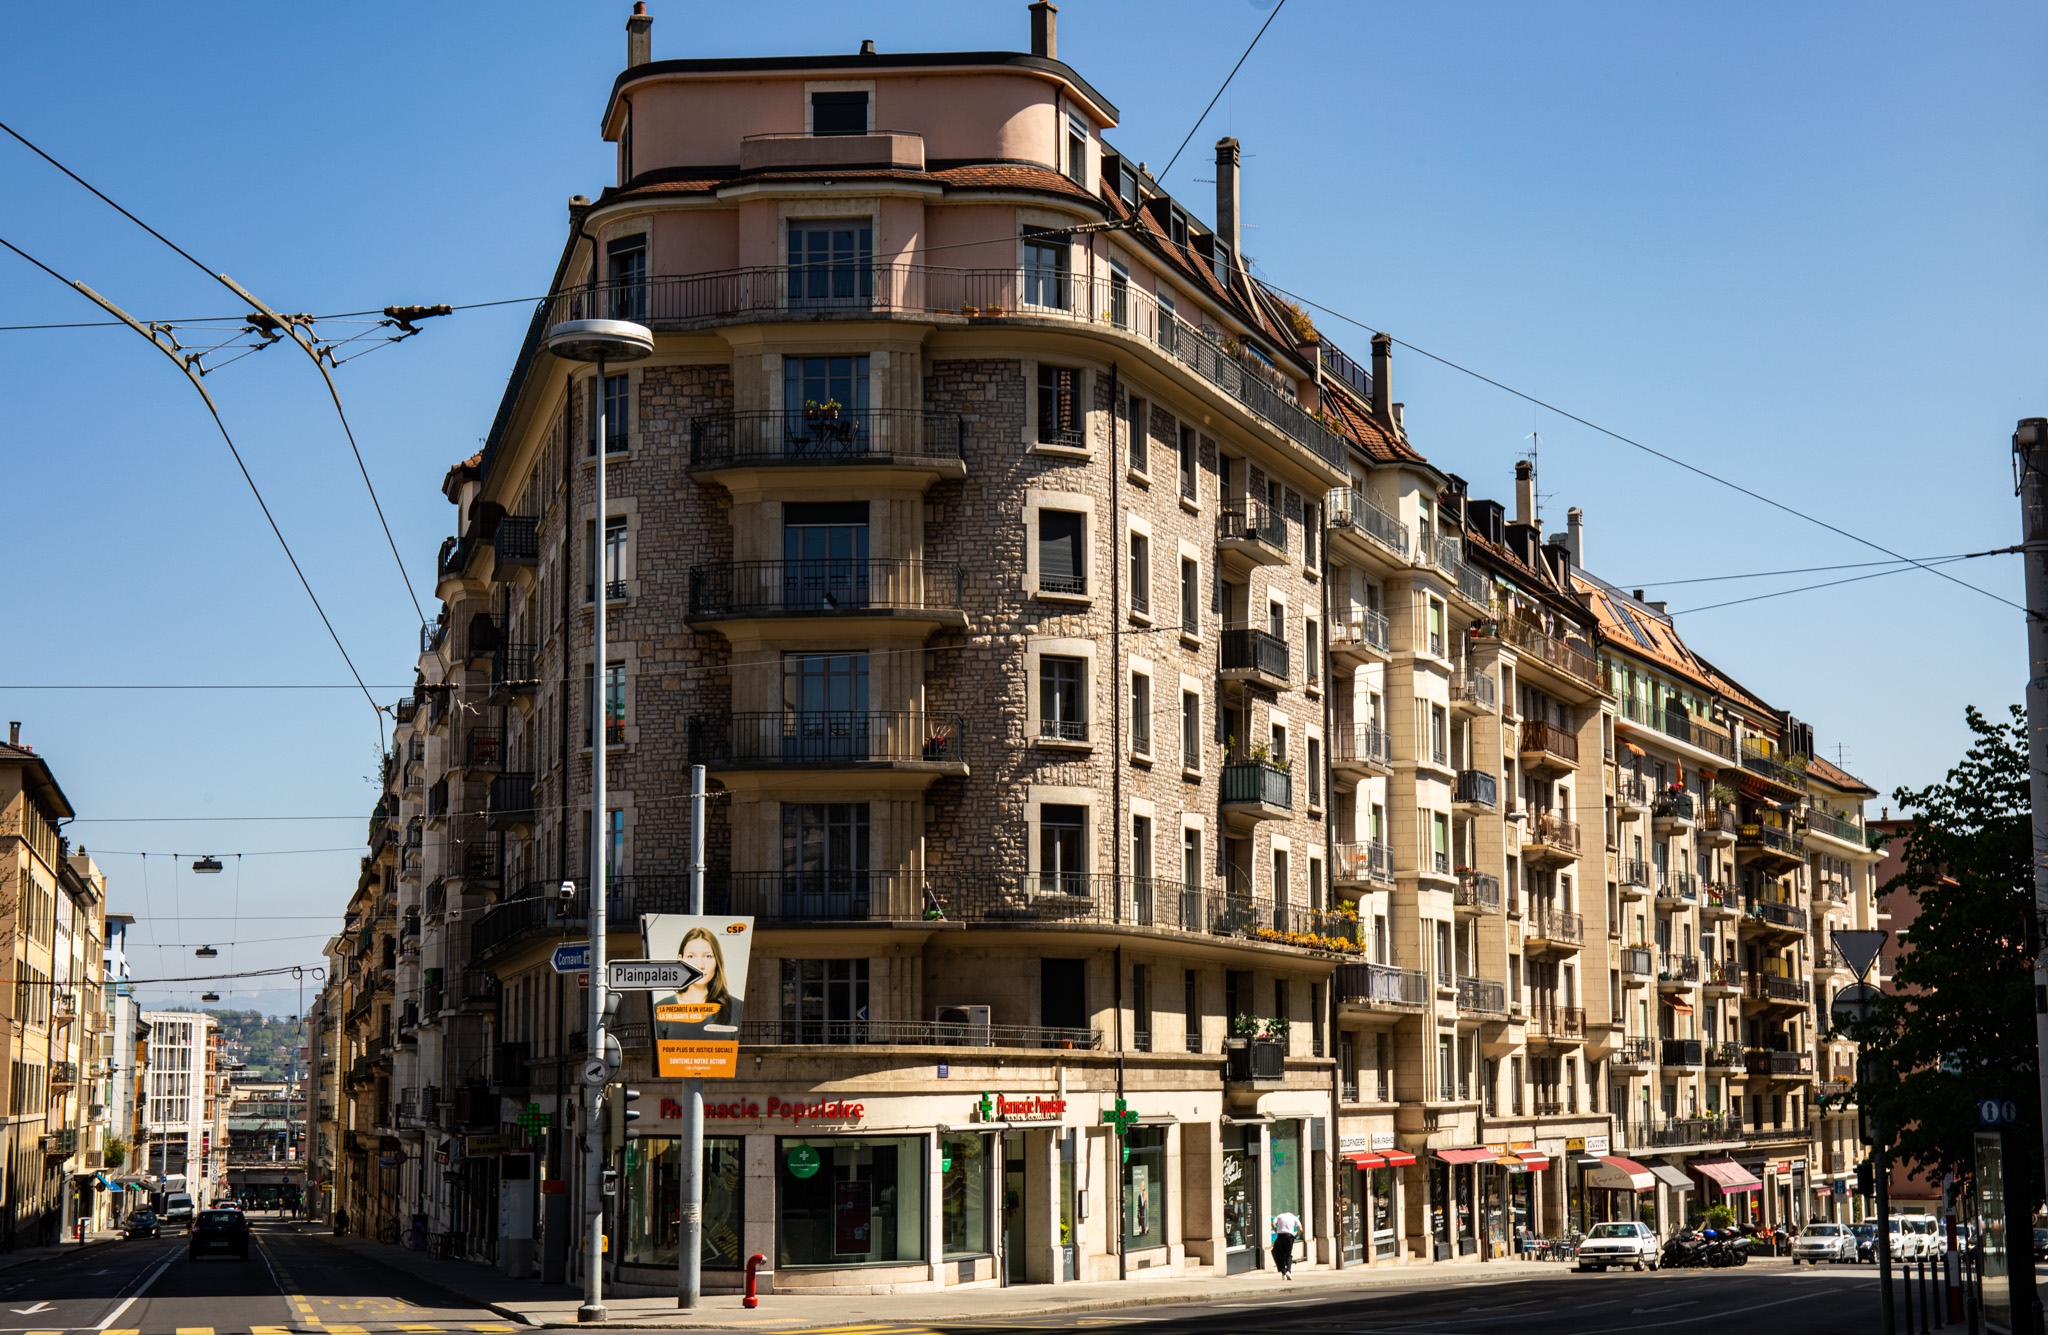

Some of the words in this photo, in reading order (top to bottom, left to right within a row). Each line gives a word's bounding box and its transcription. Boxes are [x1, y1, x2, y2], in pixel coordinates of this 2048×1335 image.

[558, 952, 582, 966] Cornavin
[616, 967, 678, 985] Plainpalais
[665, 1005, 688, 1013] PRÉCARITÉ
[669, 1057, 692, 1065] SOUTENEZ
[693, 1057, 709, 1065] NOTRE
[709, 1057, 727, 1065] ACTION
[660, 1097, 759, 1119] Phmacie
[767, 1097, 865, 1123] Populaire
[996, 1095, 1034, 1115] Pharmacie
[1035, 1095, 1067, 1118] Populaire
